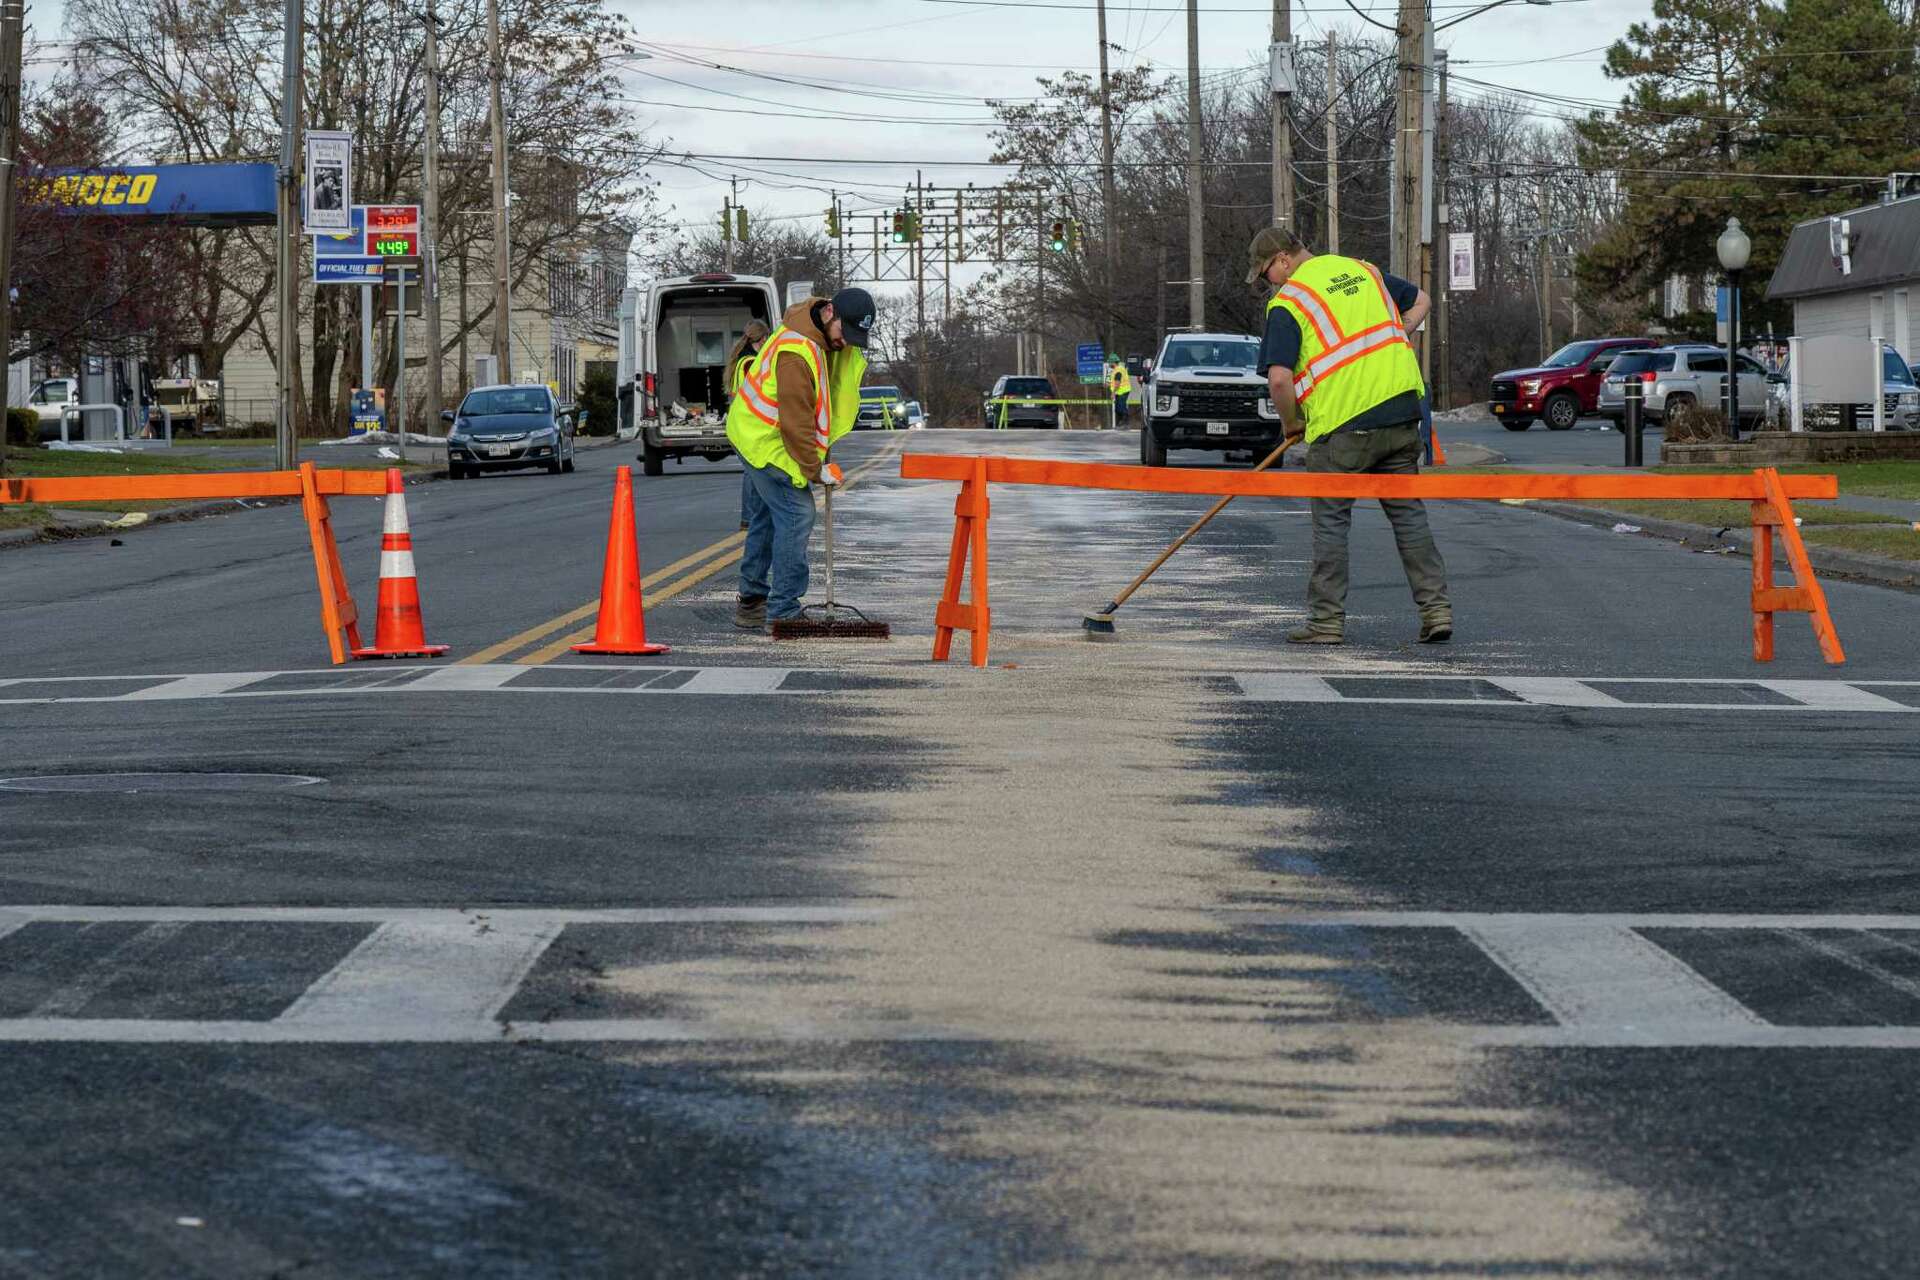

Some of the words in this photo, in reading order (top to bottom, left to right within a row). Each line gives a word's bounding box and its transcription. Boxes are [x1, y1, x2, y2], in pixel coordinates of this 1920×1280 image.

[319, 264, 347, 273] OFFICIAL
[349, 264, 365, 273] FUEL
[1326, 275, 1366, 294] ENVIRONMENTAL
